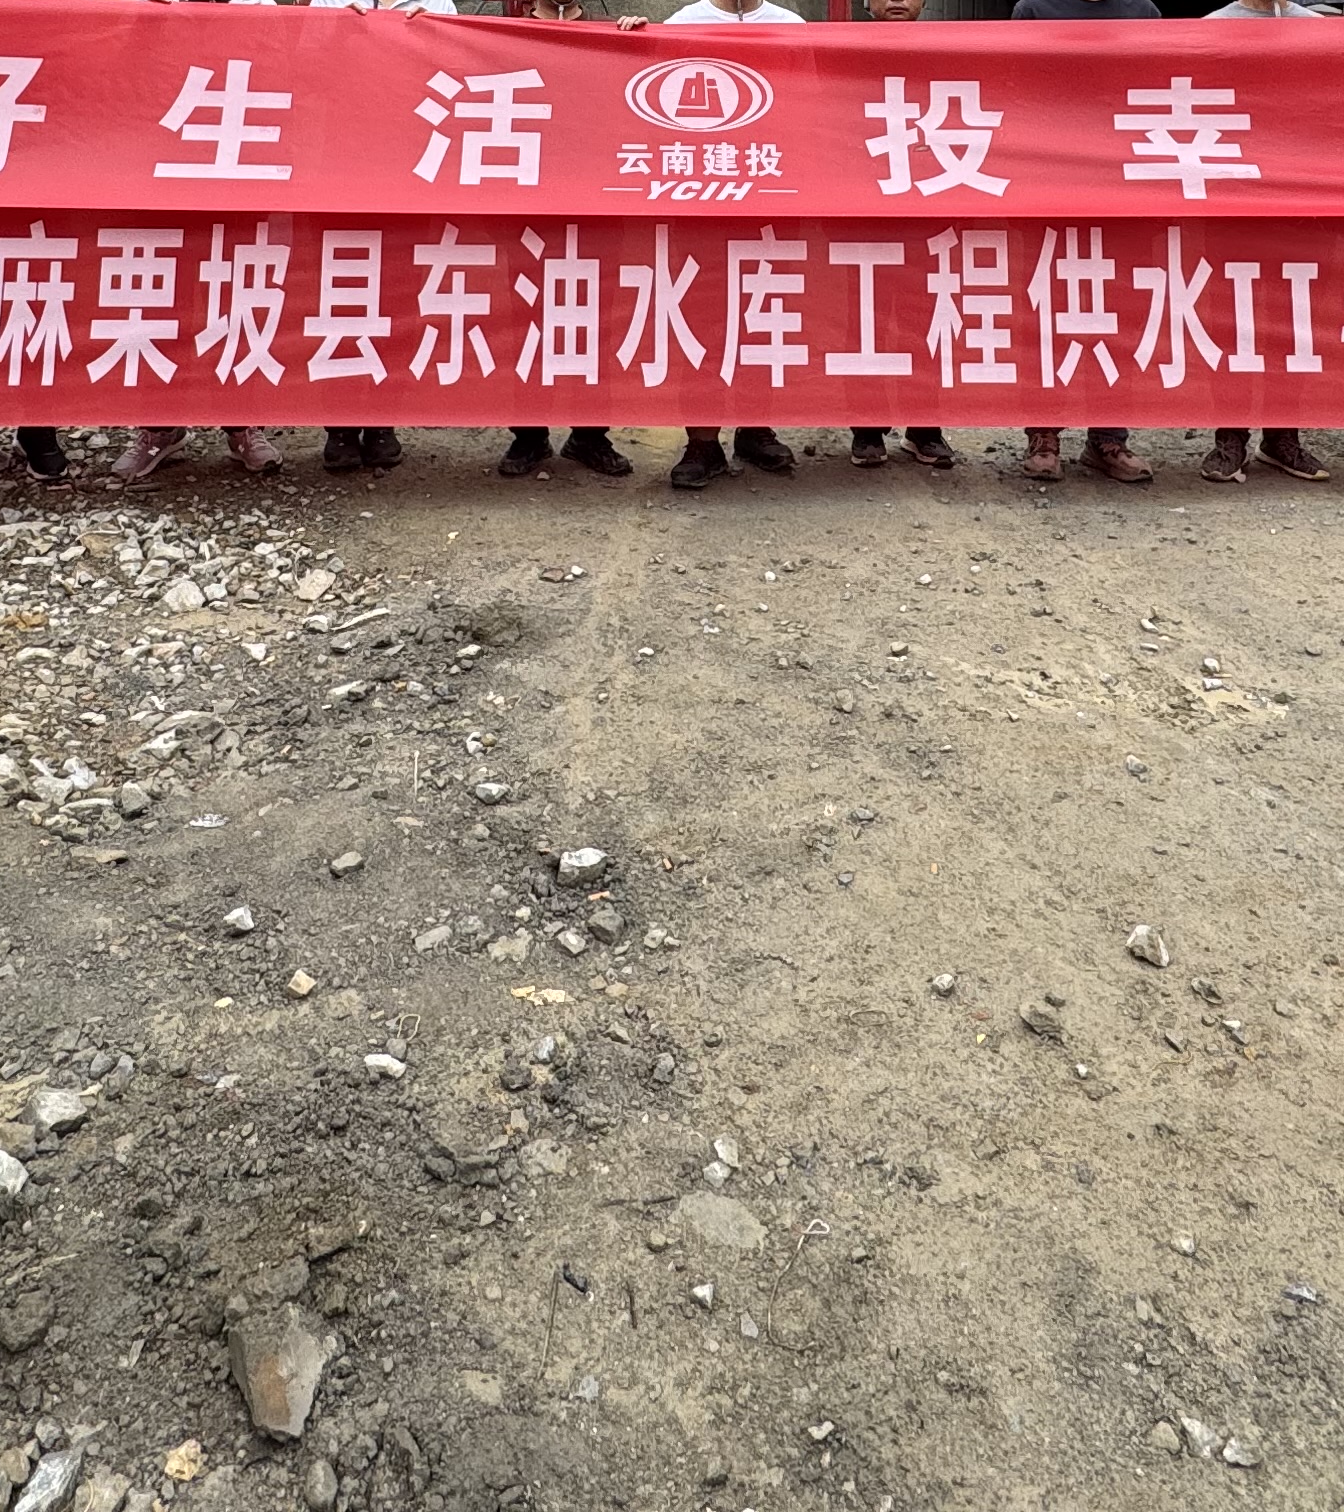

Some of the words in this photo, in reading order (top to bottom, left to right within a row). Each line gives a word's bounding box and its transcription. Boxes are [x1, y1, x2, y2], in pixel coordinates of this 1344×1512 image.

[616, 142, 783, 177] 云南建投
[647, 181, 754, 201] YCIH
